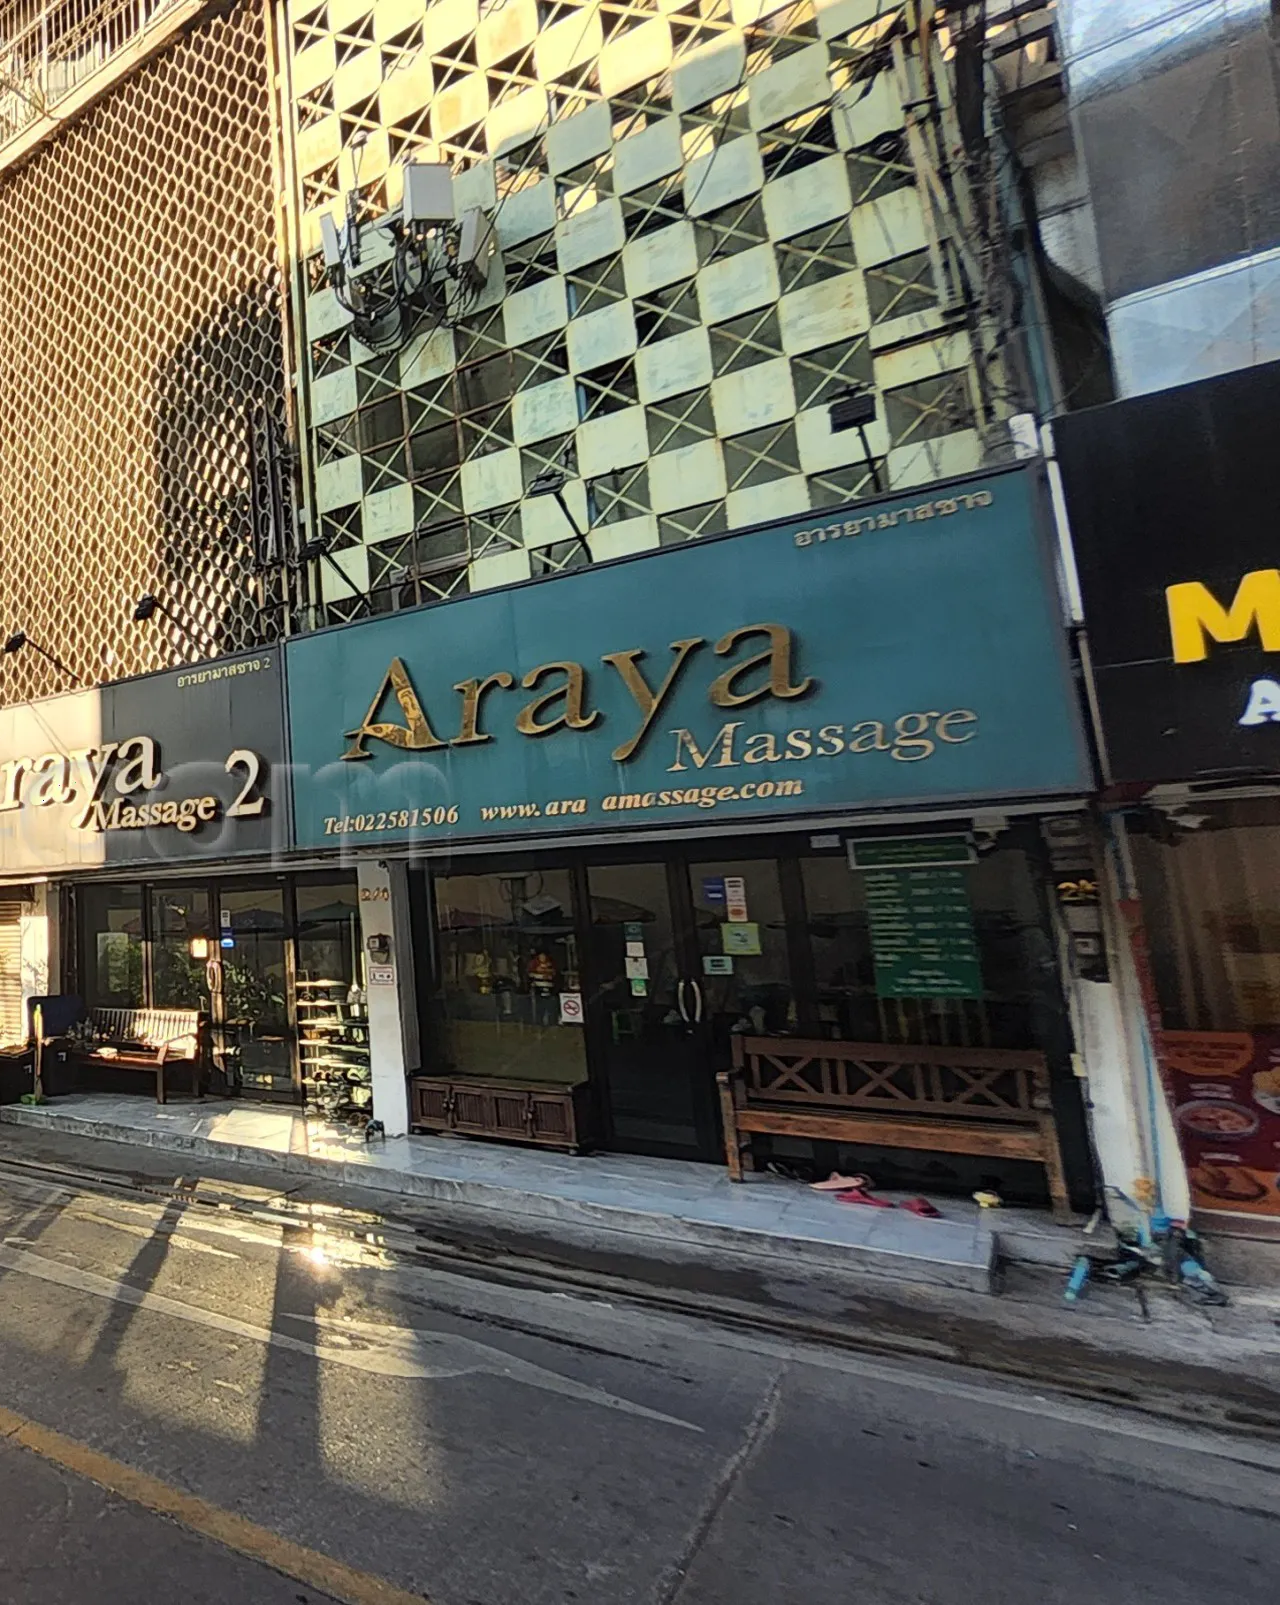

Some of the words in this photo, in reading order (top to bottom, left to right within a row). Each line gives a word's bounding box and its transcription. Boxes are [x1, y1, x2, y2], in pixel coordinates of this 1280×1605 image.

[263, 657, 271, 668] 2
[339, 622, 818, 763] Araya
[665, 706, 979, 773] Massage
[89, 793, 216, 834] Massage
[225, 750, 266, 817] 2
